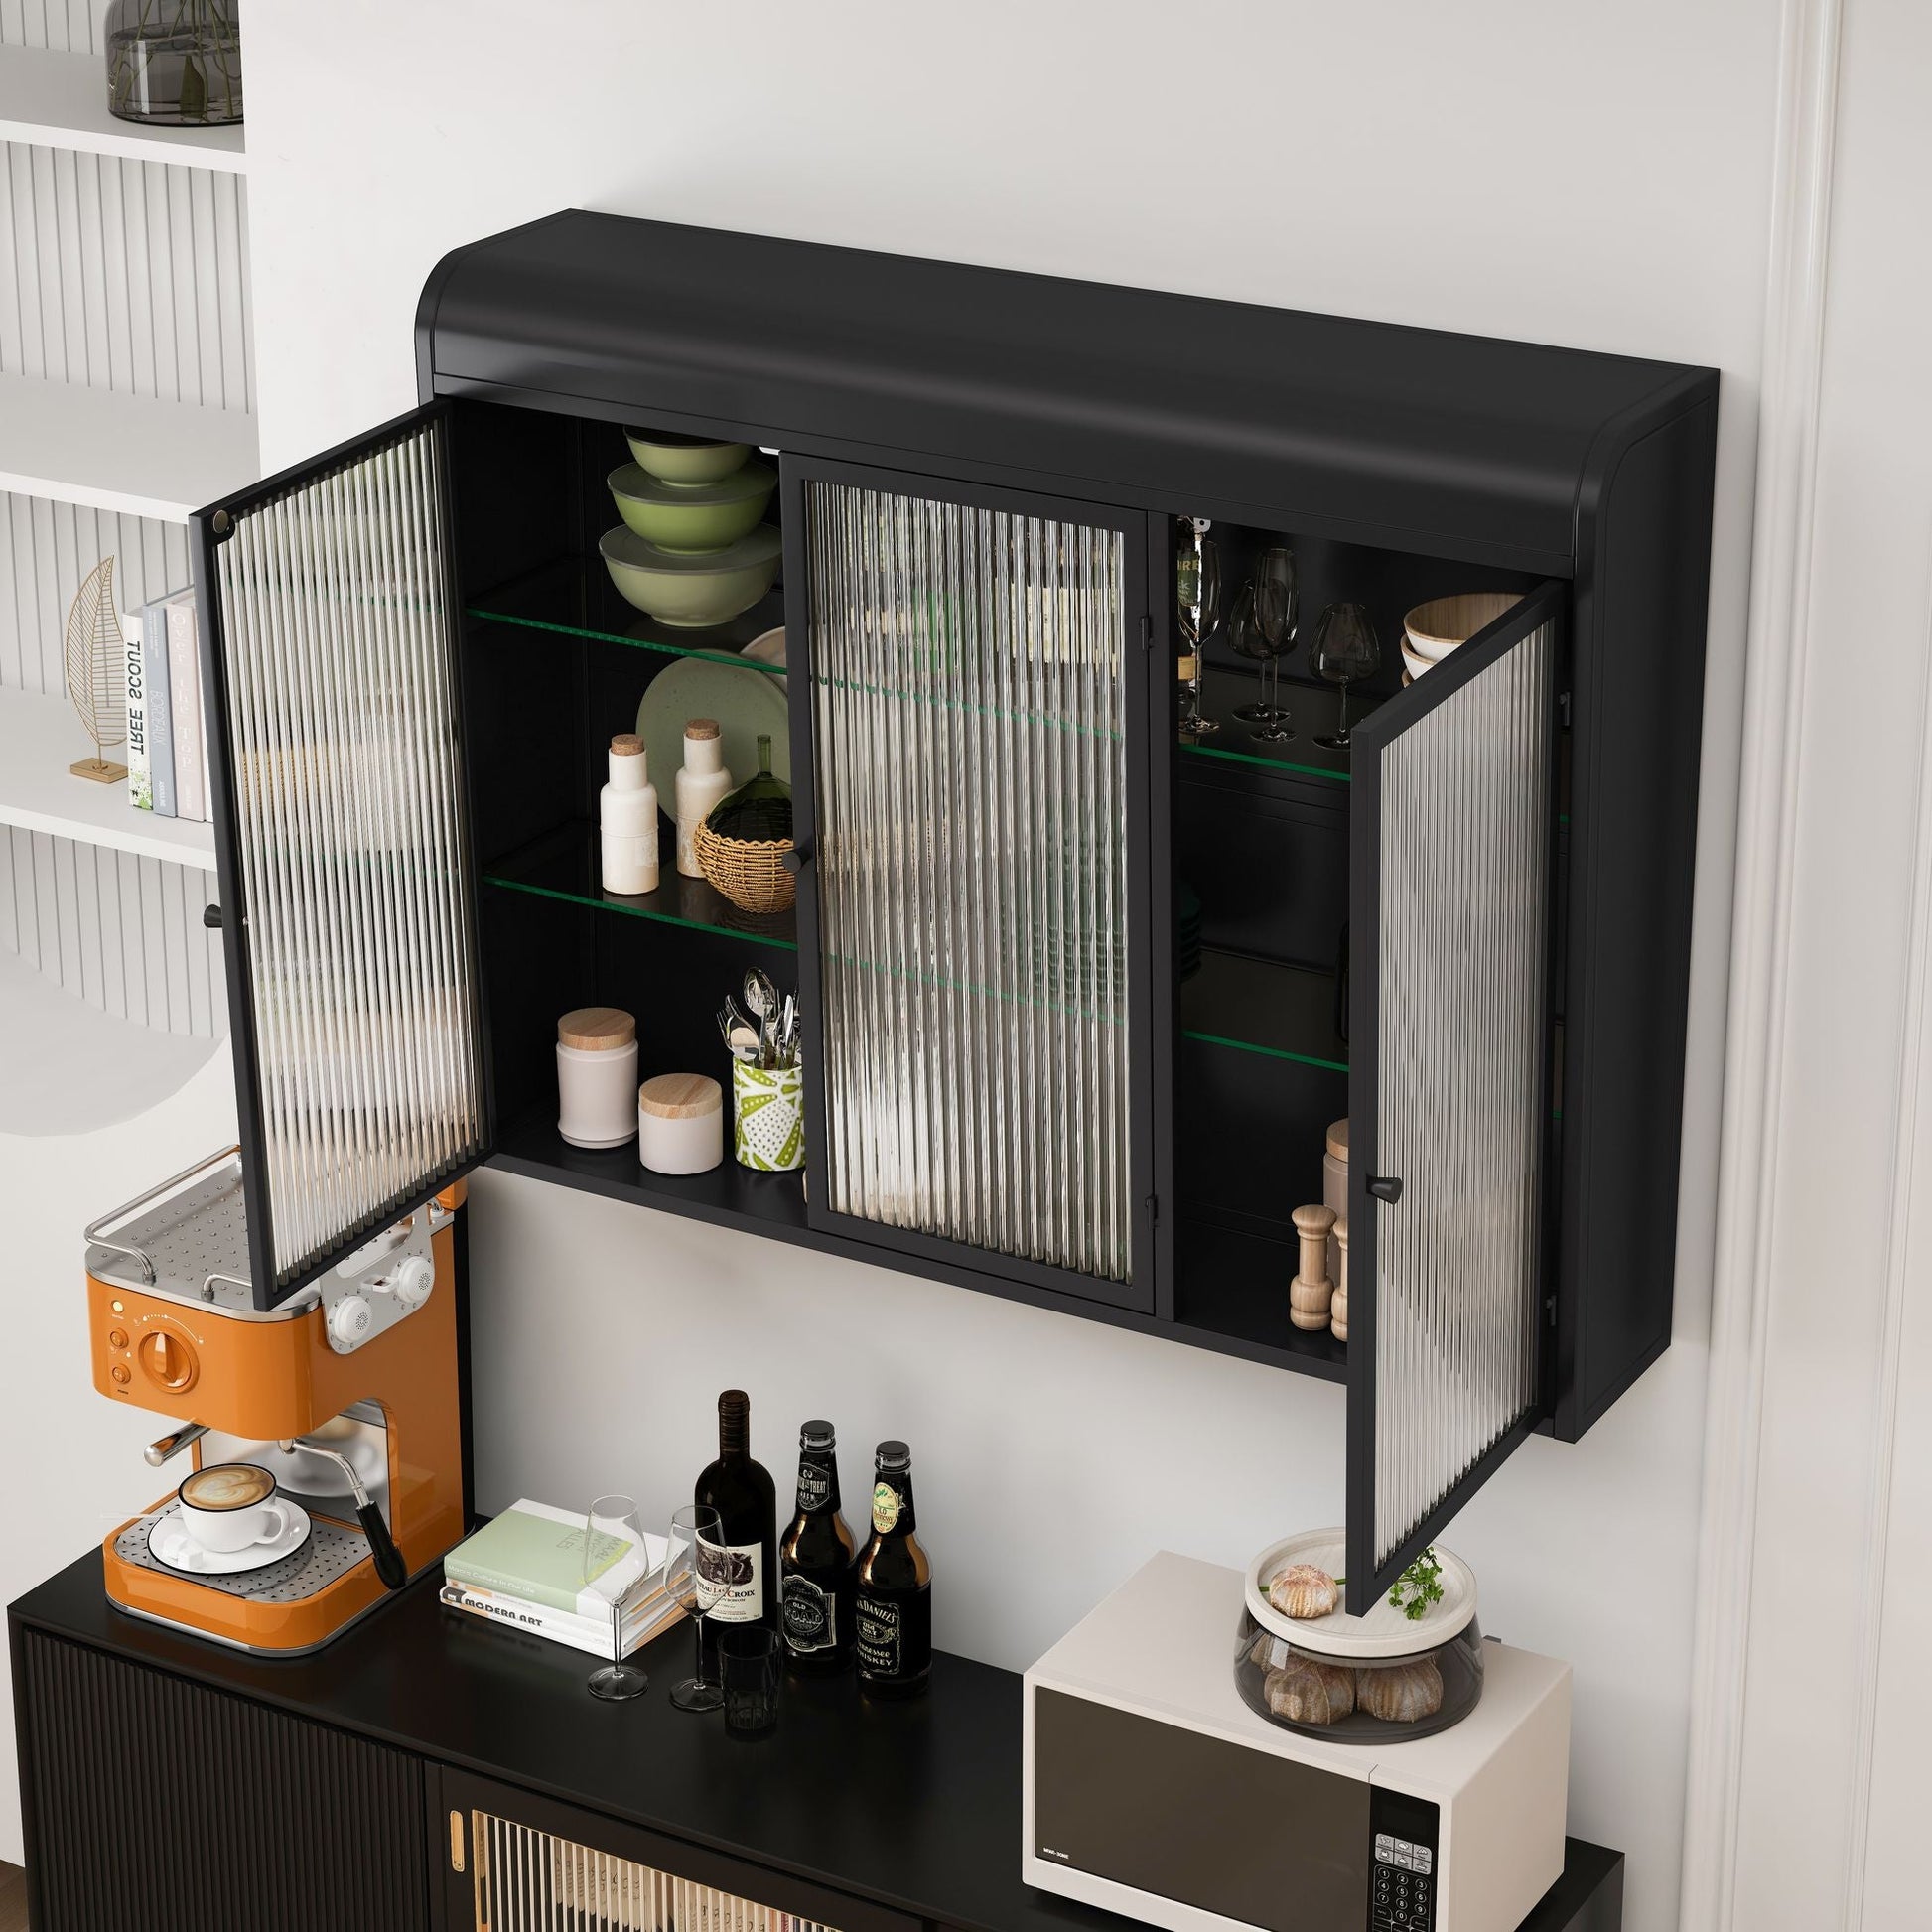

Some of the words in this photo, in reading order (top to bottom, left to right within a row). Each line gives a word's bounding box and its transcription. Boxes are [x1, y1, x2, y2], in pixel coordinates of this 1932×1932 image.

[150, 690, 167, 746] BORDEAUX
[727, 1589, 756, 1598] CROIX
[465, 1597, 517, 1620] MODERN
[520, 1614, 543, 1627] ART
